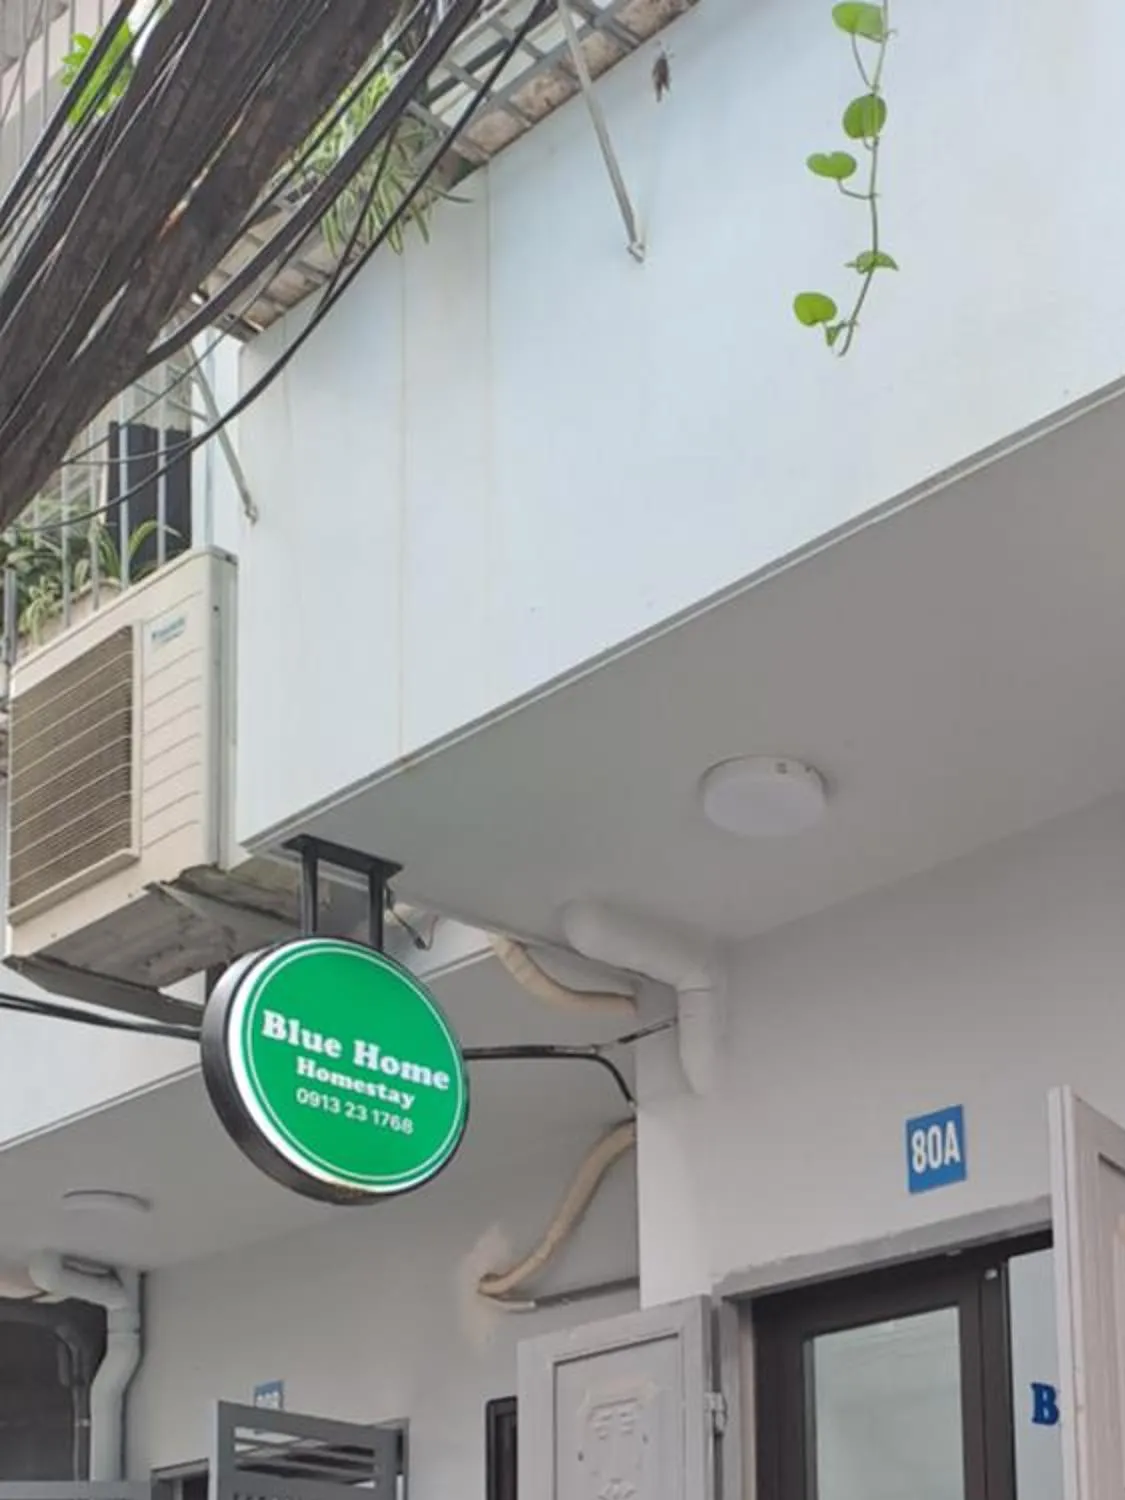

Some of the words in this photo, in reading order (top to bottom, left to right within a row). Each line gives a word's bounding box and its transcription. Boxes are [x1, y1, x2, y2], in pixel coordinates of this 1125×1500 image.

[261, 1009, 343, 1058] Blue
[352, 1039, 451, 1090] Home
[296, 1056, 416, 1109] Homestay
[296, 1087, 341, 1114] 0913
[344, 1101, 368, 1122] 23
[912, 1120, 961, 1174] 80A
